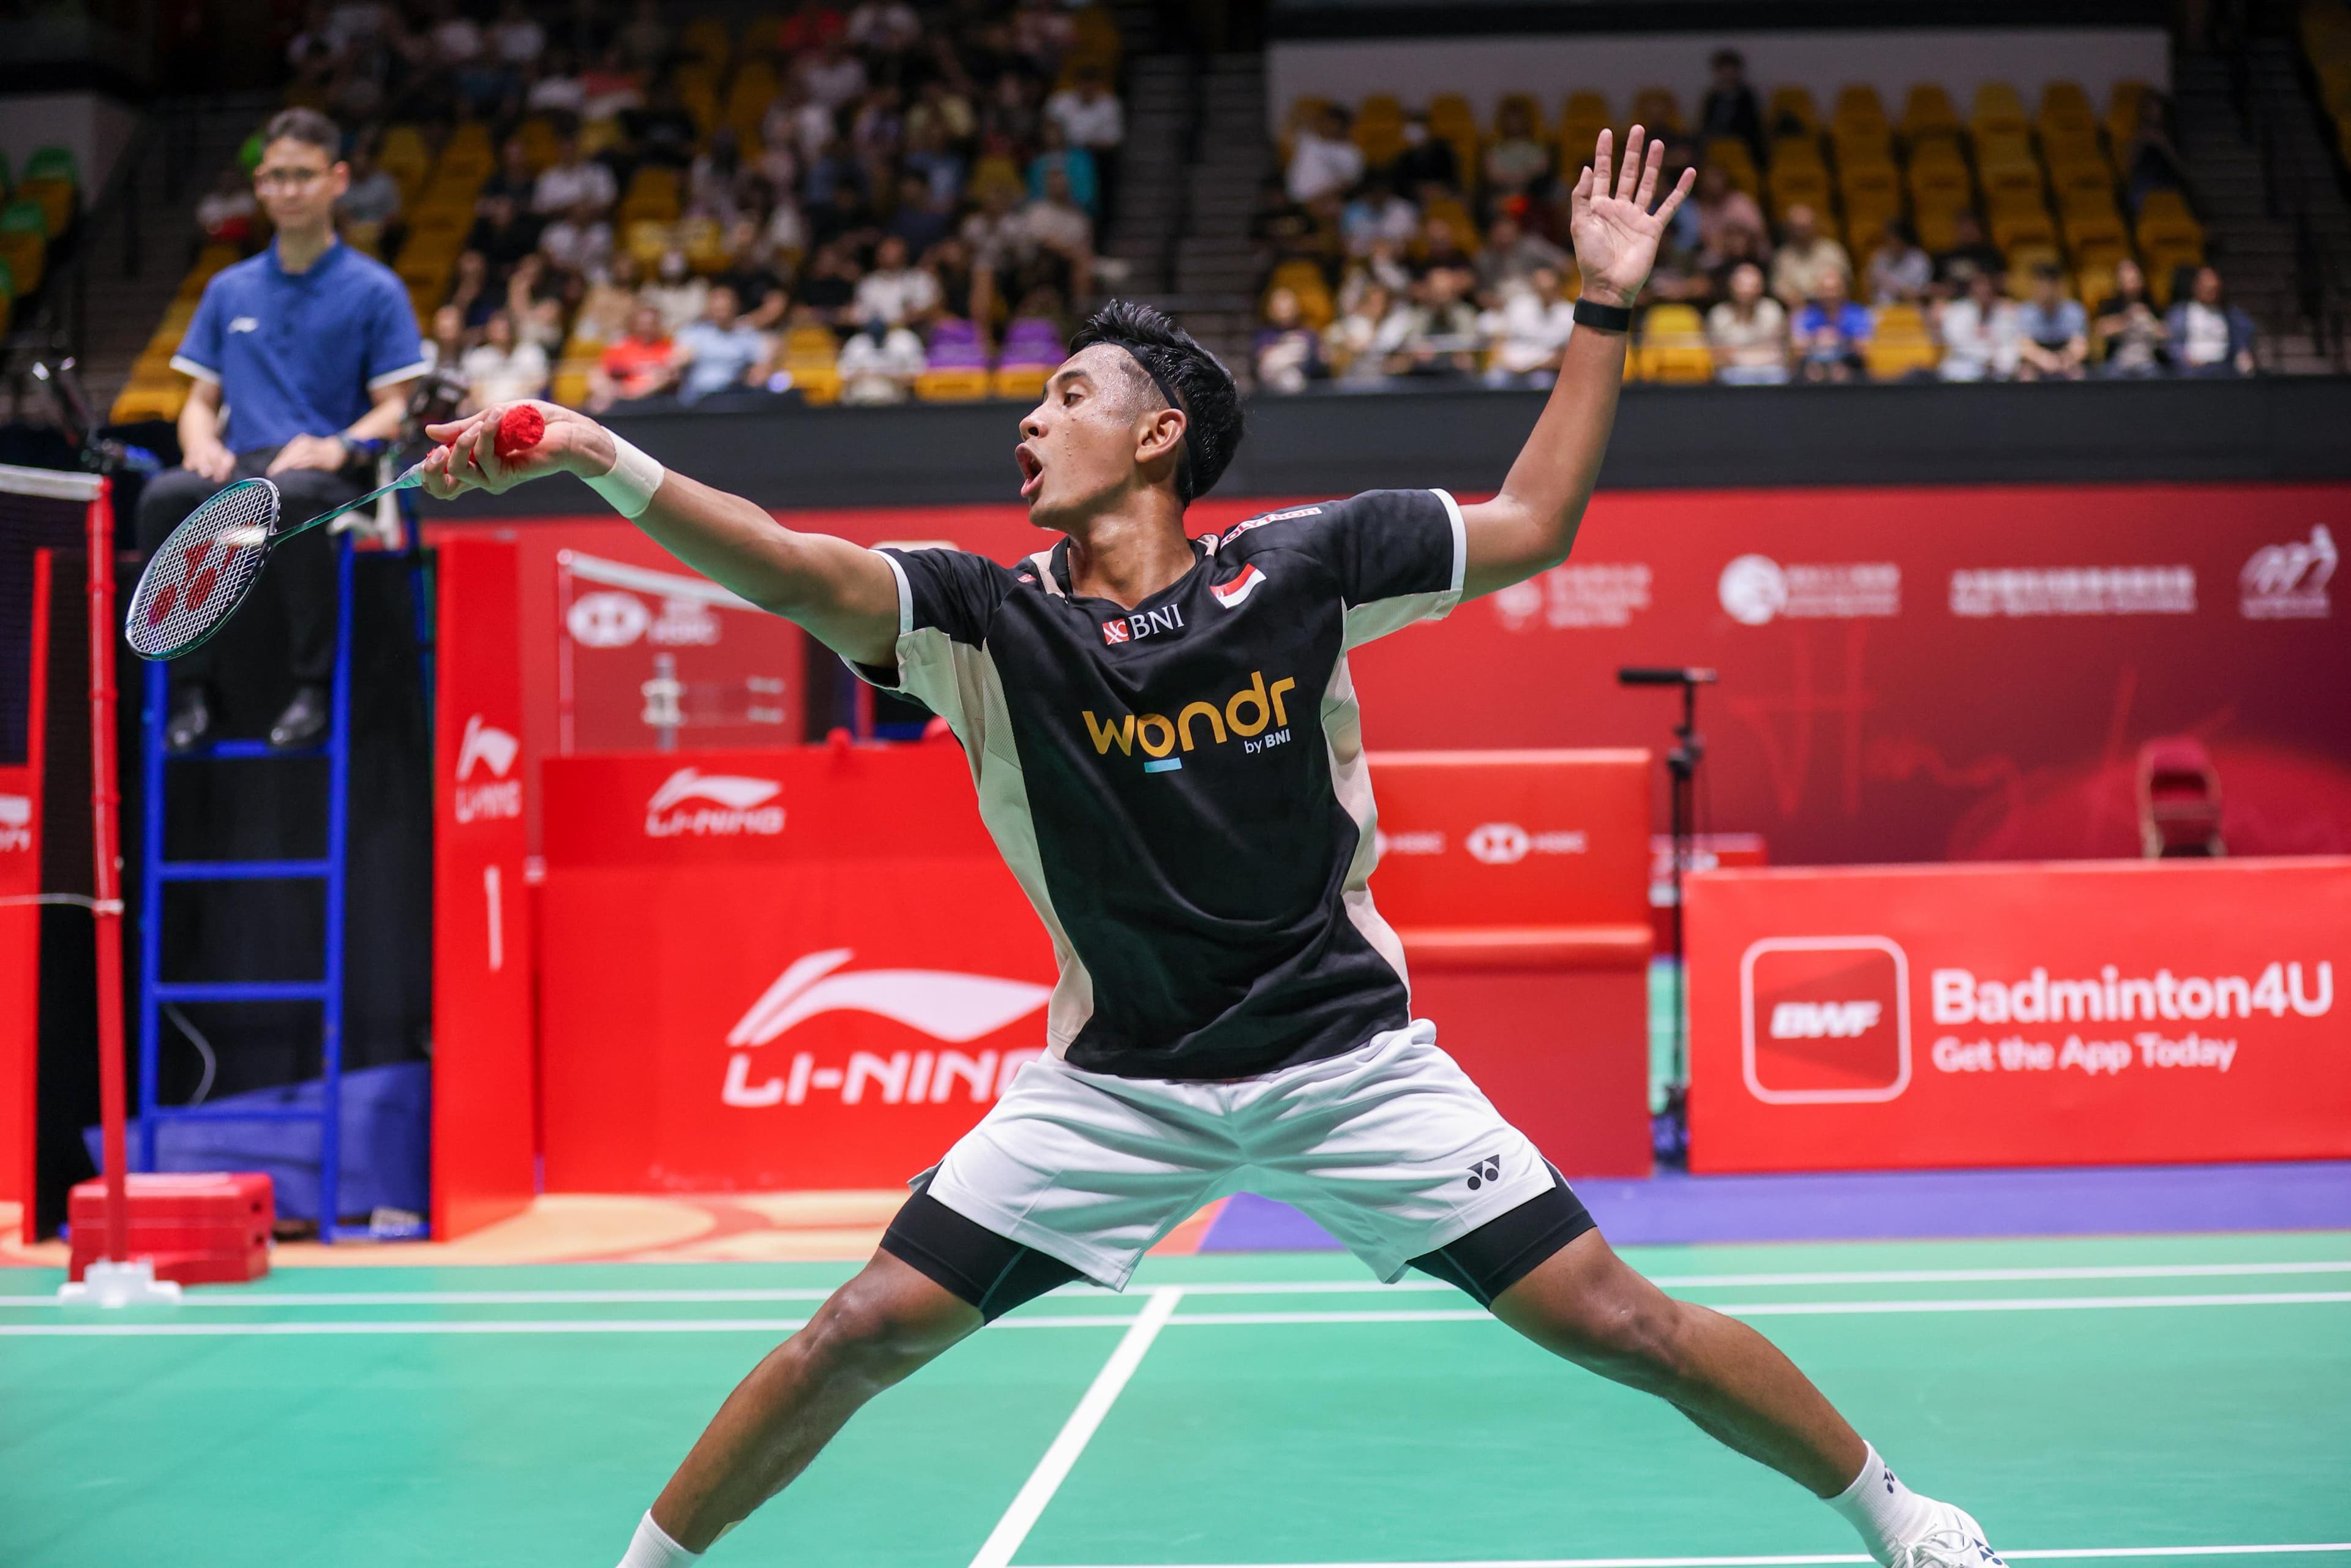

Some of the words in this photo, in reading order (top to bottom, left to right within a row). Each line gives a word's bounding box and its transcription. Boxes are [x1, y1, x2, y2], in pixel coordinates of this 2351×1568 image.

[1221, 509, 1319, 546] OLYTRON
[1128, 603, 1185, 640] BNI
[1082, 670, 1295, 758] wondr
[1243, 740, 1262, 754] by
[1264, 729, 1291, 749] BNI
[1932, 960, 2333, 1024] Badminton4U
[1771, 1000, 1881, 1038] BWF
[1932, 1035, 1995, 1072] Get
[1998, 1035, 2055, 1071] the
[2058, 1033, 2132, 1076] App
[2134, 1032, 2238, 1073] Today
